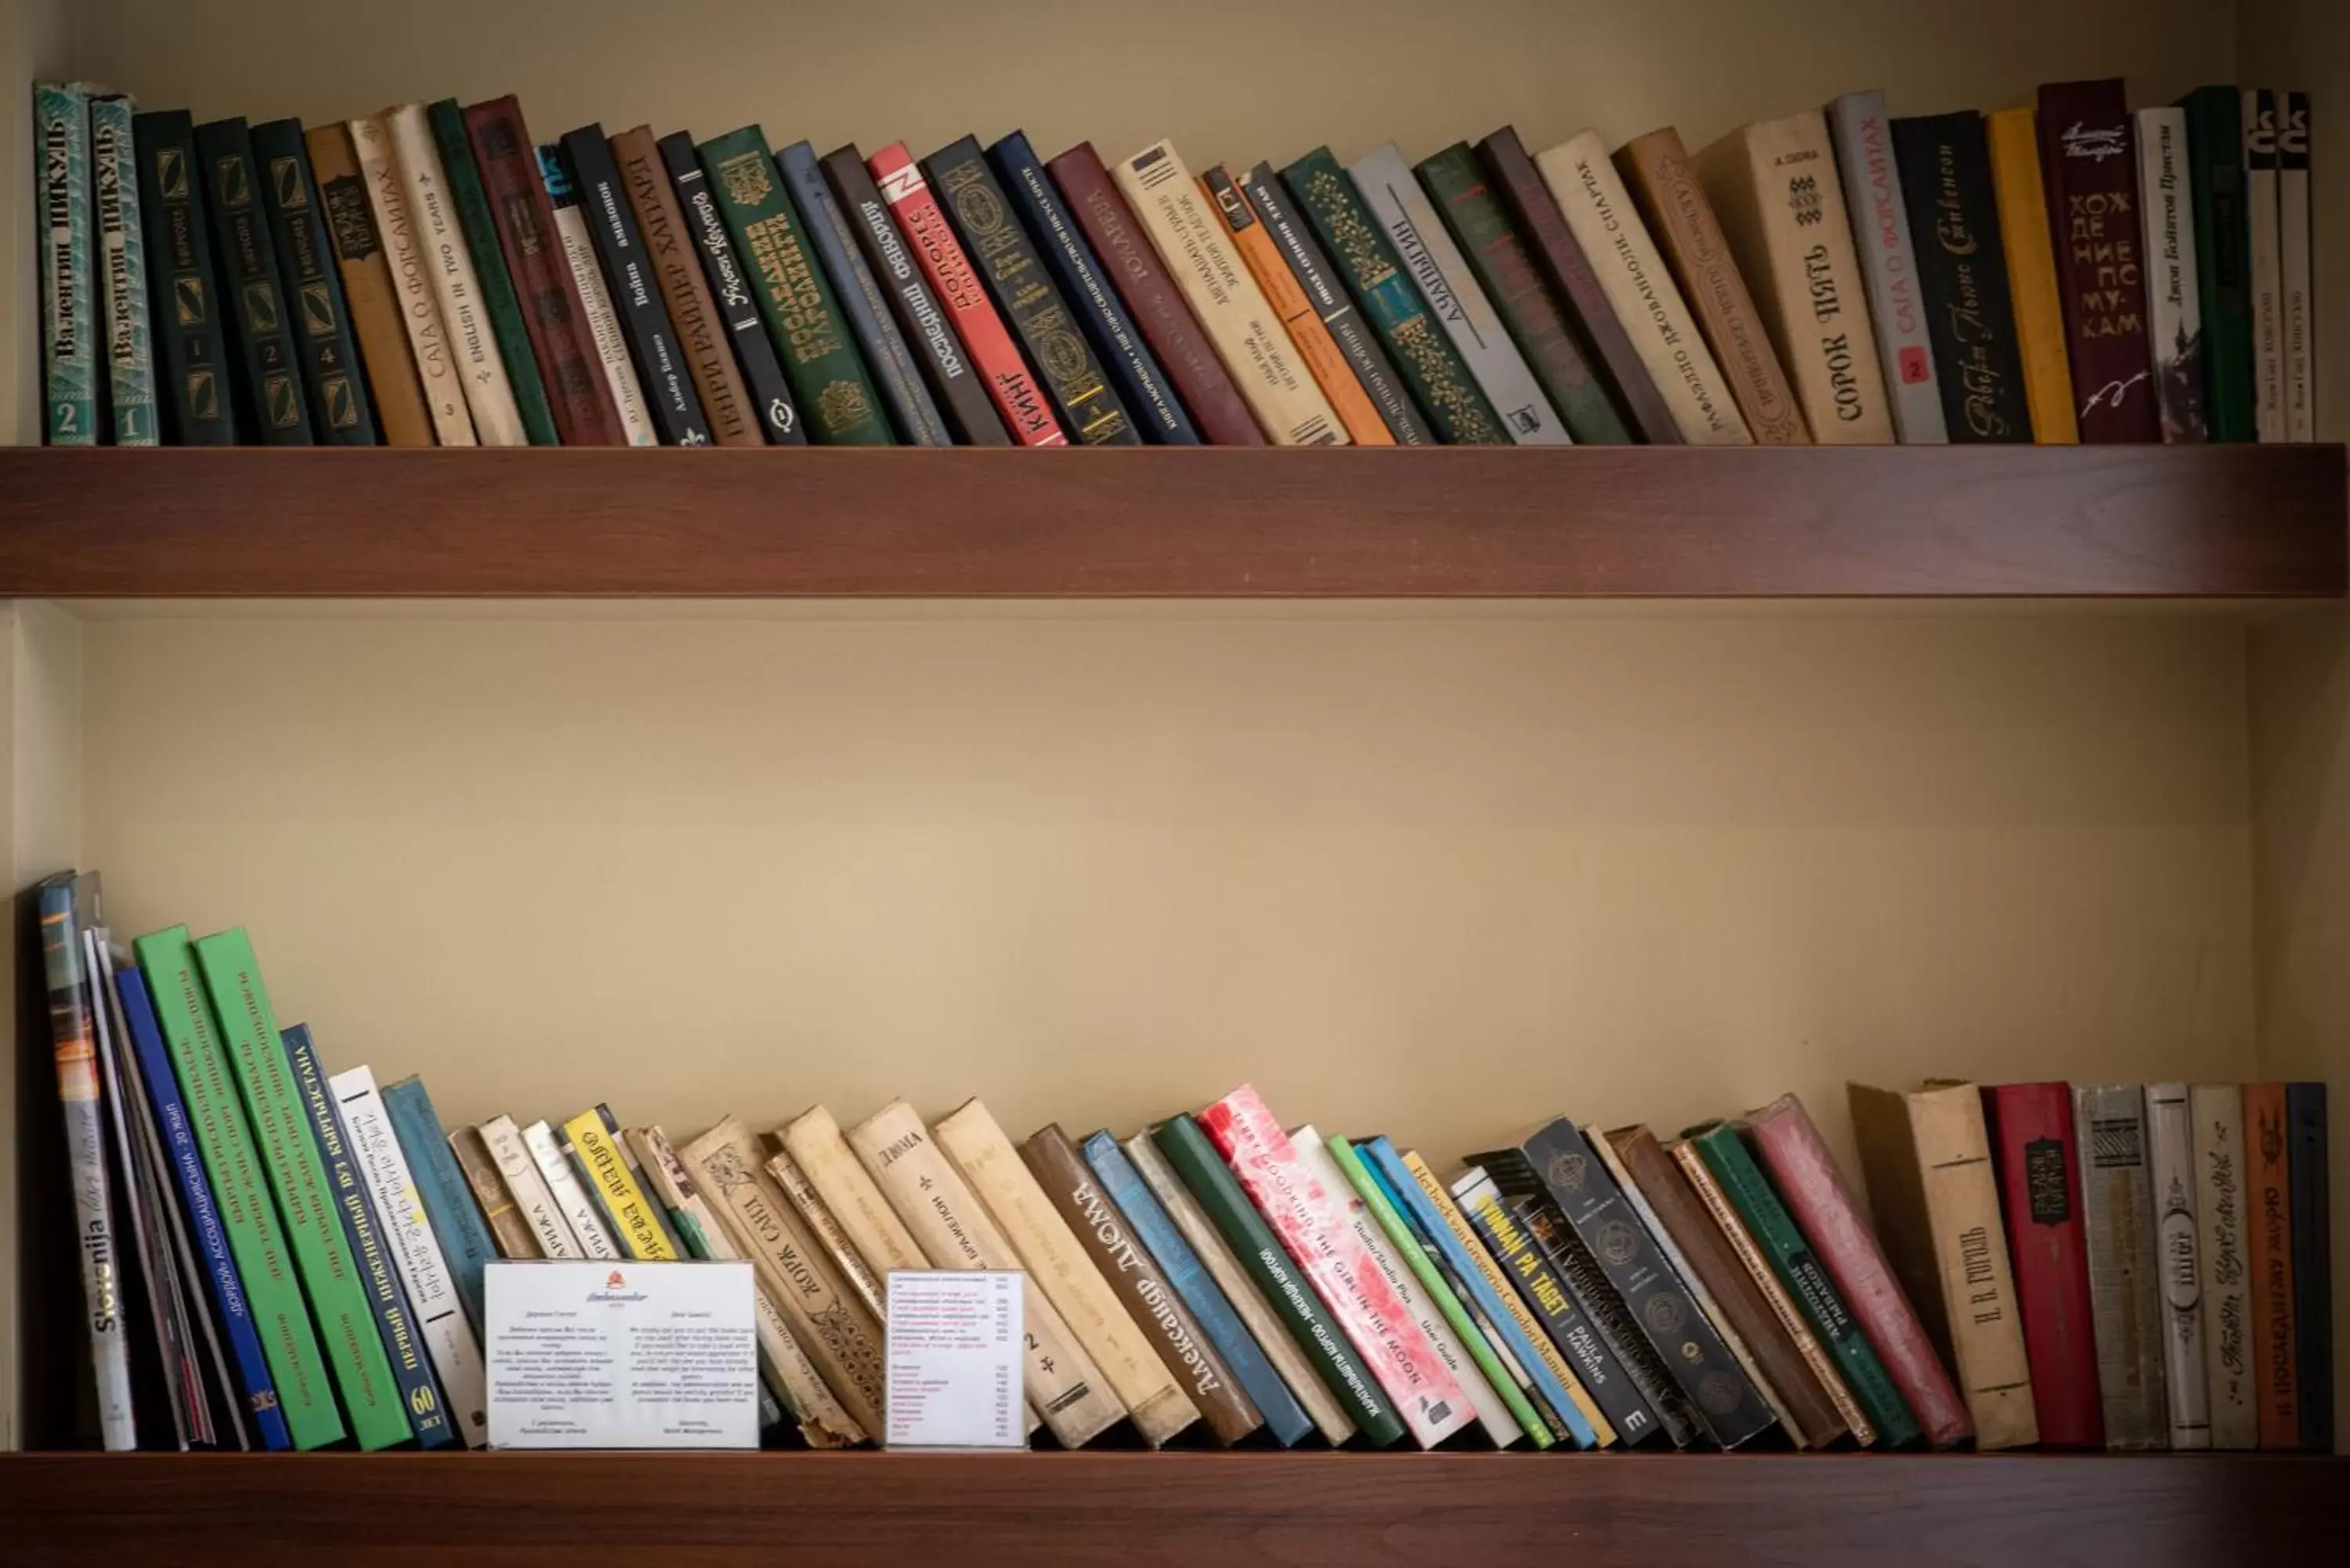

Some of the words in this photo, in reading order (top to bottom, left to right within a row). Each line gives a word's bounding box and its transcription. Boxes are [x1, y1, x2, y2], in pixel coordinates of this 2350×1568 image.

[45, 120, 69, 230] ПИКУЛЬ
[94, 127, 121, 234] ПИКУЛЬ
[624, 154, 679, 259] ХАГГАРД
[1570, 157, 1624, 233] СПАРТАК
[1852, 115, 1907, 250] ФОРСАЙТАХ
[1919, 141, 1977, 259] Стивенсон
[421, 190, 447, 237] YEARS
[596, 179, 631, 249] амазонок
[1078, 186, 1155, 285] ТОКАРЕВА
[2070, 215, 2105, 241] ДЕ
[436, 241, 460, 276] TWO
[620, 260, 652, 309] Война
[906, 208, 971, 314] ДОЛОРЕС
[1801, 242, 1842, 325] ПЯТЬ
[1885, 253, 1904, 275] О
[2073, 240, 2131, 266] НИЕ
[50, 242, 76, 359] Валентин
[106, 246, 134, 362] Валентин
[410, 299, 430, 320] О
[449, 281, 466, 299] IN
[660, 258, 719, 356] РАЙДЕР
[743, 219, 819, 365] ПОСЛЕДНИЕ
[1885, 276, 1922, 336] САГА
[1939, 260, 1994, 347] Льюис
[192, 339, 201, 356] 1
[264, 345, 277, 363] 2
[320, 347, 335, 363] 4
[417, 323, 446, 379] САГА
[454, 303, 487, 364] ENGLISH
[2081, 313, 2142, 339] КАМ
[664, 371, 689, 414] Альбер
[699, 358, 746, 440] ГЕНРИ
[999, 364, 1050, 434] КИНГ
[1667, 346, 1729, 433] РАФАЭЛЛО
[1821, 332, 1864, 424] СОРОК
[1952, 341, 2014, 442] Роберт
[58, 403, 78, 434] 2
[123, 406, 139, 437] 1
[291, 1044, 344, 1158] КЫРГЫЗСТАНА
[332, 1160, 353, 1189] ВУЗ
[873, 1124, 926, 1168] ДЮМА
[341, 1191, 396, 1304] ИНЖЕНЕРНЫЙ
[740, 1193, 784, 1246] САНД
[927, 1194, 981, 1261] БРАЖЕЛОН
[1065, 1180, 1147, 1277] ДЮМА
[77, 1217, 125, 1335] Slovenija
[774, 1242, 821, 1300] ЖОРЖ
[1258, 1150, 1316, 1230] GOODKIND
[1314, 1232, 1336, 1259] THE
[1331, 1259, 1359, 1294] GIRL
[1354, 1292, 1372, 1311] IN
[1366, 1310, 1390, 1338] THE
[1385, 1337, 1423, 1386] MOON
[1352, 1219, 1401, 1284] Studio/Studio
[1394, 1282, 1415, 1306] Plus
[1513, 1248, 1544, 1278] PÅ
[1954, 1224, 1998, 1287] ГОГОЛЬ
[1527, 1269, 1574, 1320] TÅGET
[1788, 1264, 1842, 1340] АНАТОЛИЙ
[1799, 1259, 1848, 1328] РЫБАКОВ
[1969, 1286, 1999, 1305] В.
[1973, 1306, 2003, 1325] Н.
[381, 1305, 421, 1371] ПЕРВЫЙ
[1124, 1272, 1229, 1399] Александр
[1419, 1318, 1441, 1342] User
[1435, 1341, 1460, 1372] Guide
[1561, 1328, 1609, 1387] HAWKINS
[1571, 1322, 1607, 1364] PAULA
[410, 1385, 436, 1413] 60
